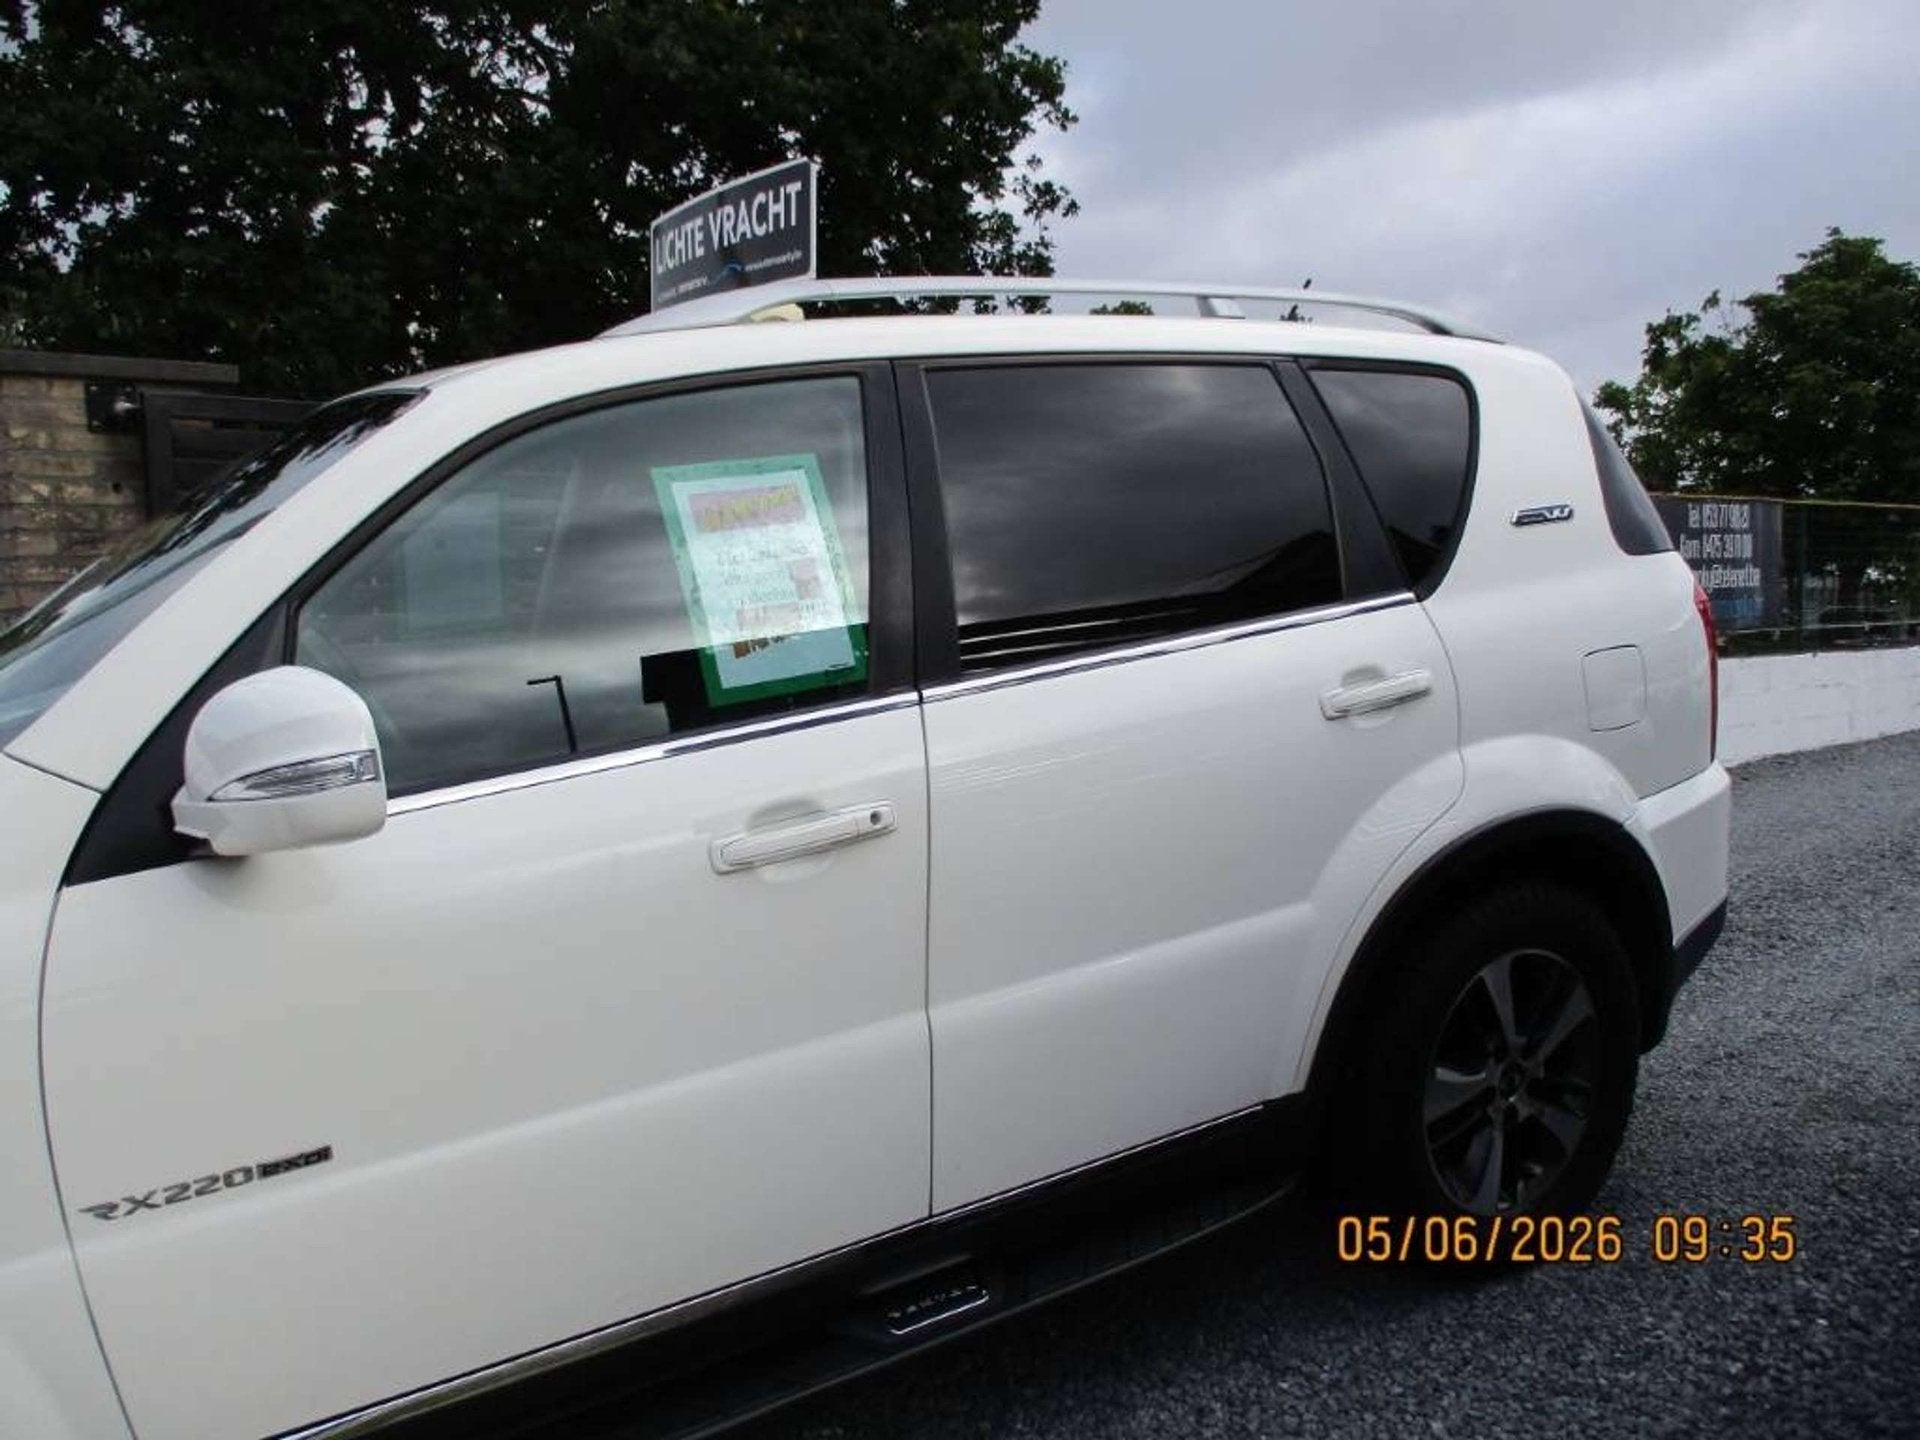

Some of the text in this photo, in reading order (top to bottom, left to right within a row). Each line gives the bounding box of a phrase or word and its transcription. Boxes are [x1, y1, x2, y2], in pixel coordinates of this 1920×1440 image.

[655, 181, 802, 274] LICHTE VRACHT
[78, 1165, 254, 1221] RX220
